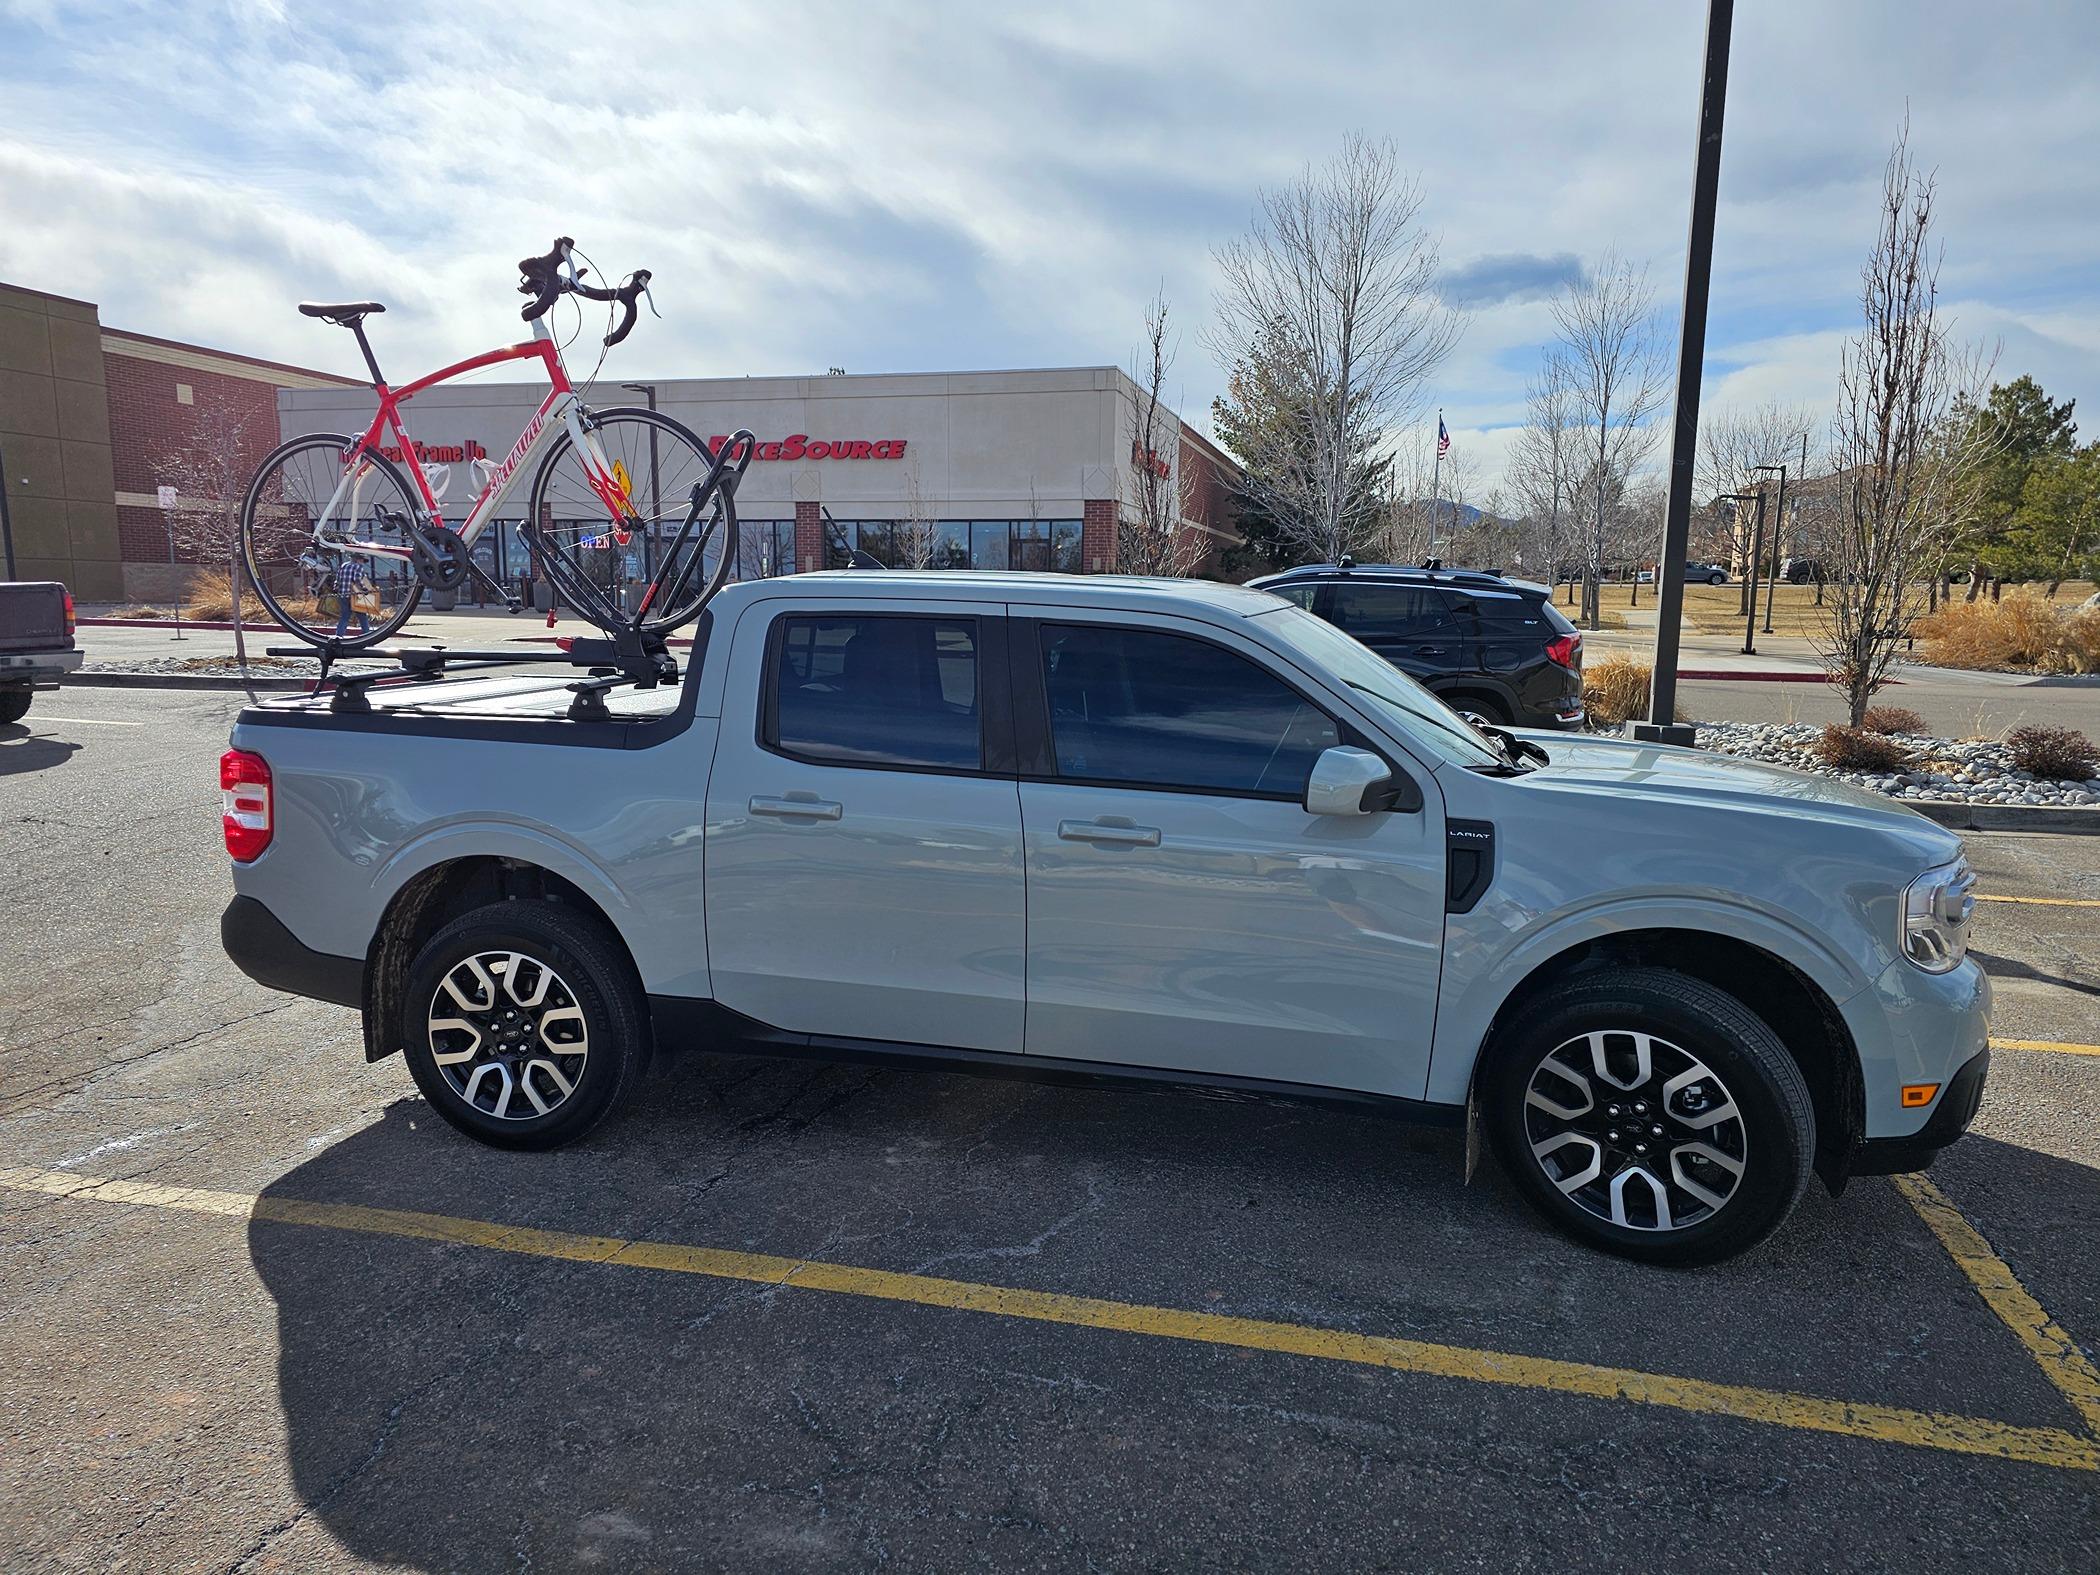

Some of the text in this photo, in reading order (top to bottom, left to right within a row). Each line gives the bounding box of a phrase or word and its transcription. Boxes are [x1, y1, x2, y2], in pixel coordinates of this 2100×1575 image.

[490, 412, 545, 500] SPECIALIZED
[580, 535, 610, 549] OPEN
[1449, 831, 1491, 839] LARIAT
